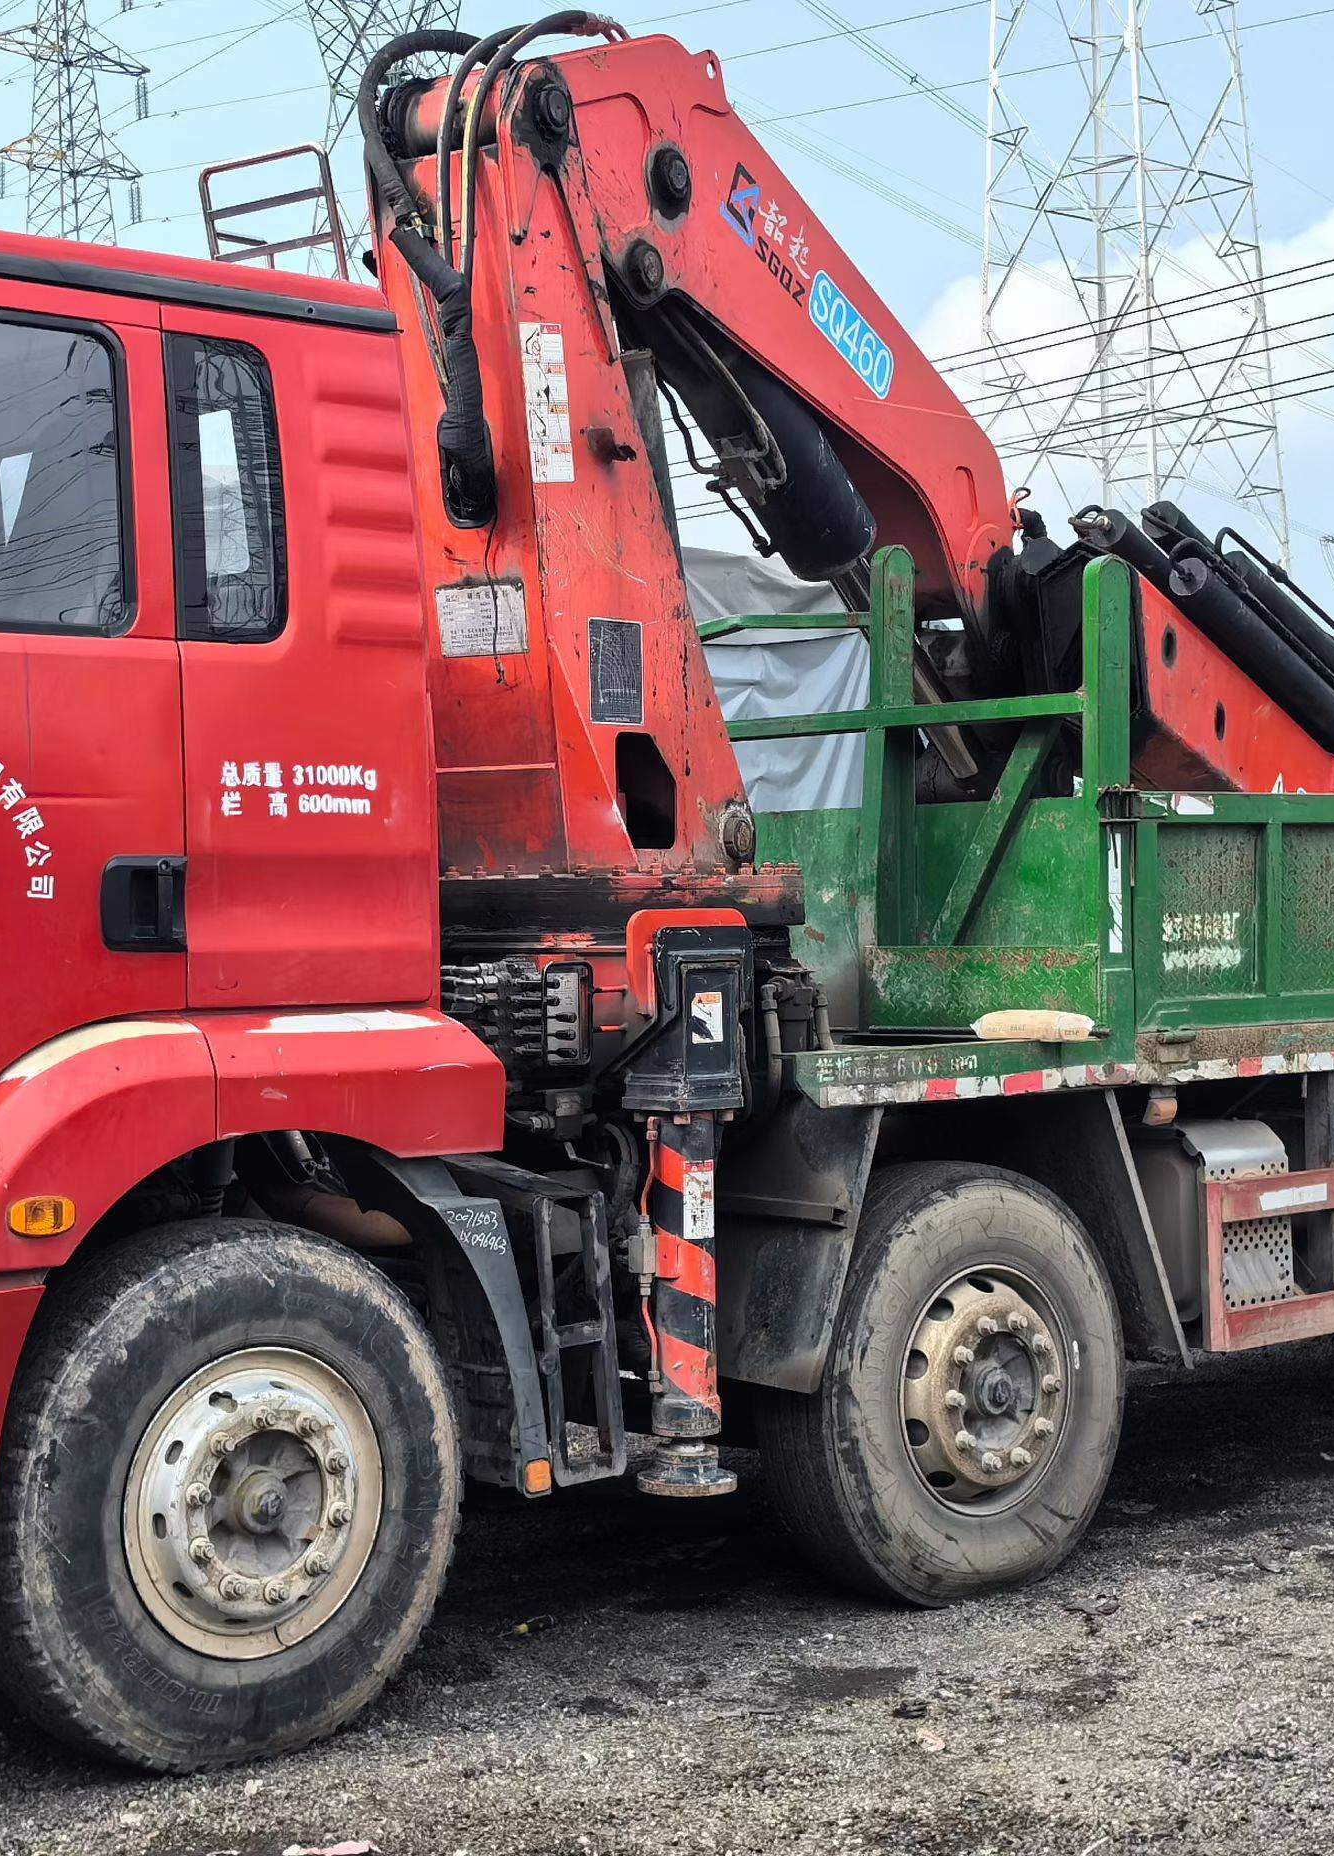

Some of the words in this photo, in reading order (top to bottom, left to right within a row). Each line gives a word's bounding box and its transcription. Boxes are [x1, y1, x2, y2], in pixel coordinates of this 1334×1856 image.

[755, 236, 806, 308] SGQZ
[813, 279, 892, 393] SQ460
[220, 761, 283, 788] 总质量
[298, 793, 371, 814] 600mm
